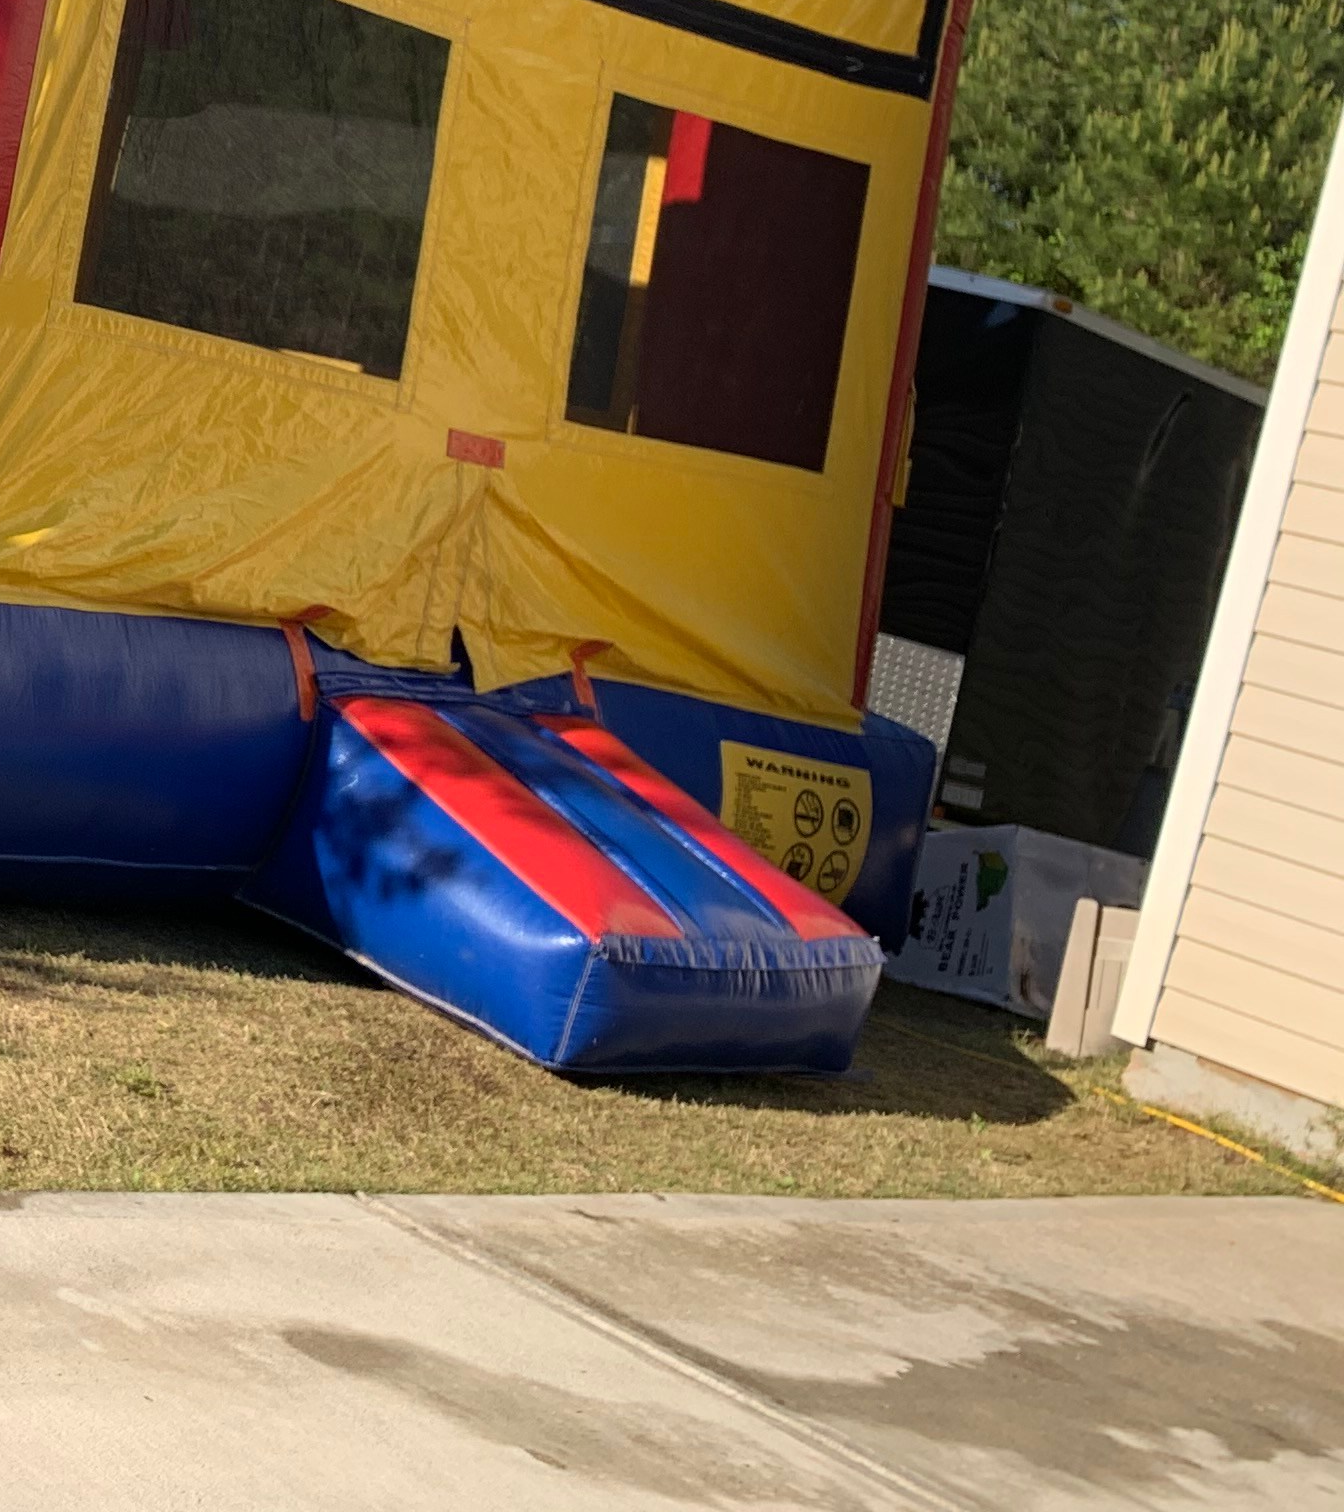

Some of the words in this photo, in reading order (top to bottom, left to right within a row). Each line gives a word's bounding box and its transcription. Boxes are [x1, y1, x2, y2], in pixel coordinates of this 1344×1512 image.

[746, 756, 851, 788] WARNING
[938, 929, 956, 971] BEAR
[951, 863, 968, 920] POWER
